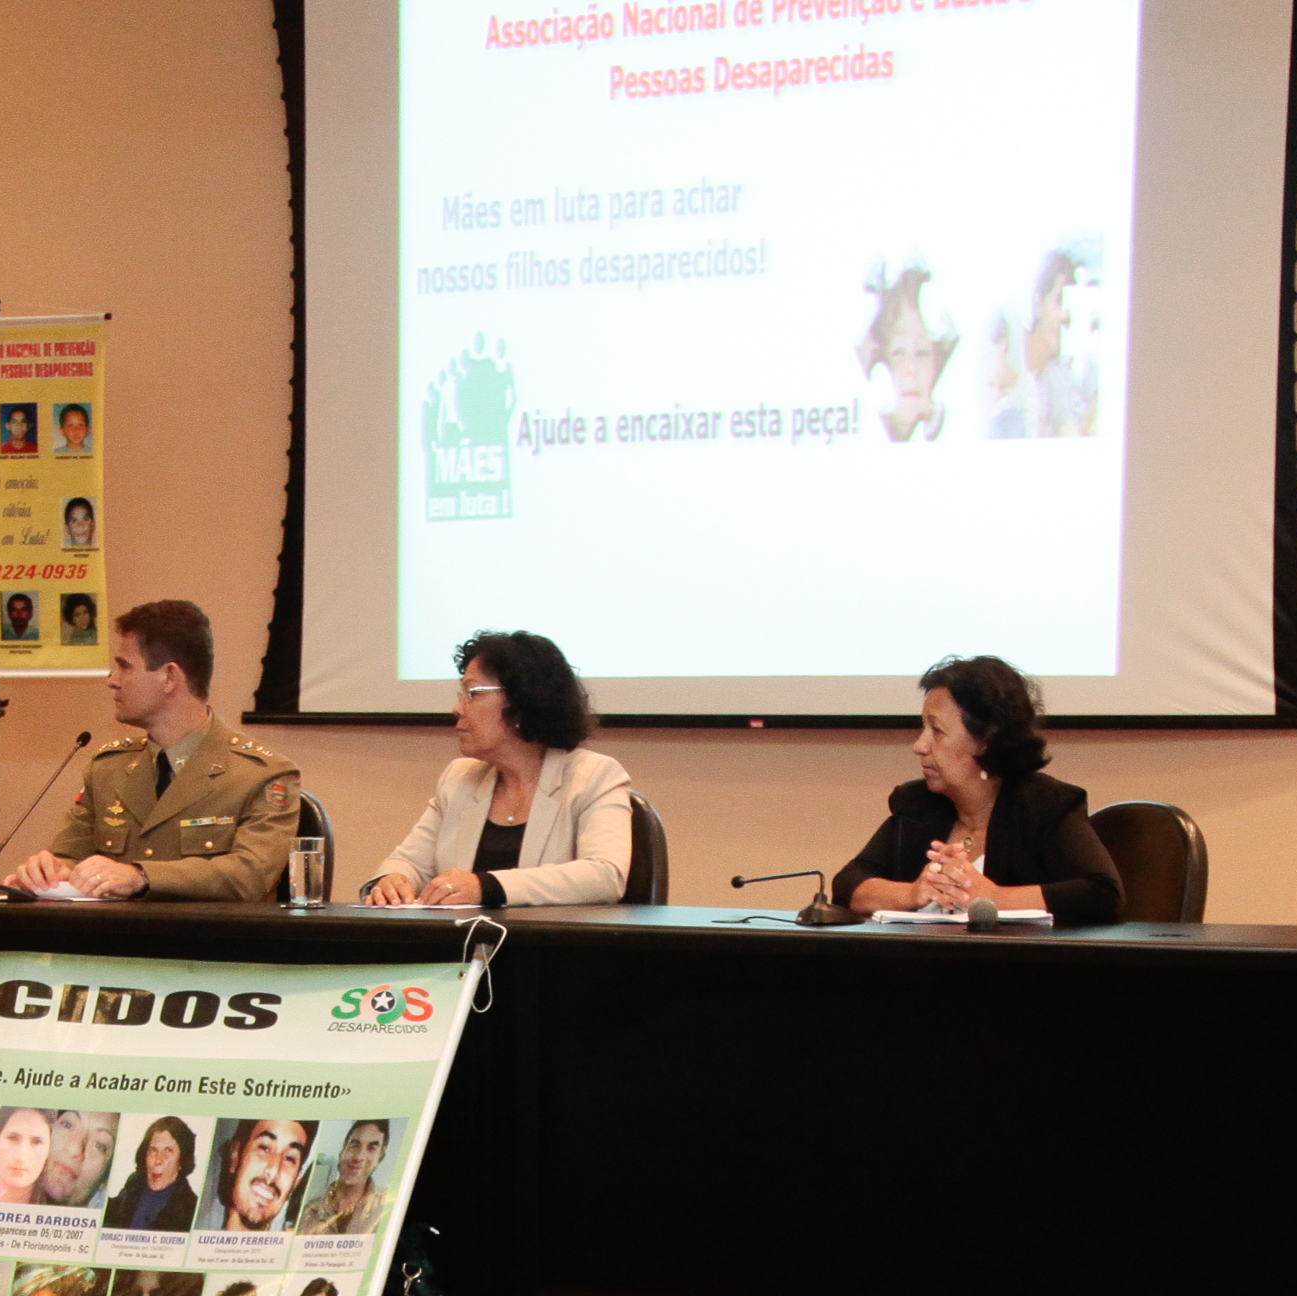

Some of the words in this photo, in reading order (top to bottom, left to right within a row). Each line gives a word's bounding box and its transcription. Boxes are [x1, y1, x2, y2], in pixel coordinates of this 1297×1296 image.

[485, 4, 614, 50] Associação
[623, 0, 726, 37] Nacional
[734, 0, 763, 26] de
[610, 65, 705, 100] Pessoas
[714, 43, 894, 97] Desaparecidas
[442, 191, 502, 231] Mães
[509, 196, 545, 227] em
[554, 186, 601, 225] luta
[609, 188, 664, 230] para
[672, 176, 743, 217] achar
[417, 262, 499, 294] nossos
[506, 250, 571, 289] filhos
[580, 238, 766, 291] desaparecidos!
[517, 407, 586, 456] Ajude
[594, 415, 608, 443] a
[616, 402, 722, 443] encaixar
[729, 402, 784, 439] esta
[792, 398, 859, 446] peça!
[434, 438, 504, 482] MÃES
[430, 497, 457, 517] em
[460, 491, 499, 516] luta
[331, 985, 434, 1024] SOS
[328, 1021, 428, 1034] DESAPARECIDOS
[14, 1068, 65, 1089] Ajude
[69, 1075, 81, 1088] a
[86, 1072, 149, 1092] Acabar
[154, 1075, 192, 1094] Com
[198, 1076, 237, 1096] Este
[28, 1228, 38, 1237] em
[35, 1215, 97, 1229] BARBOSA
[10, 1240, 21, 1249] De
[22, 1241, 72, 1254] Florianópolis
[78, 1245, 90, 1254] SC
[197, 1235, 238, 1245] LUCIANO
[240, 1236, 284, 1246] FERREIRA
